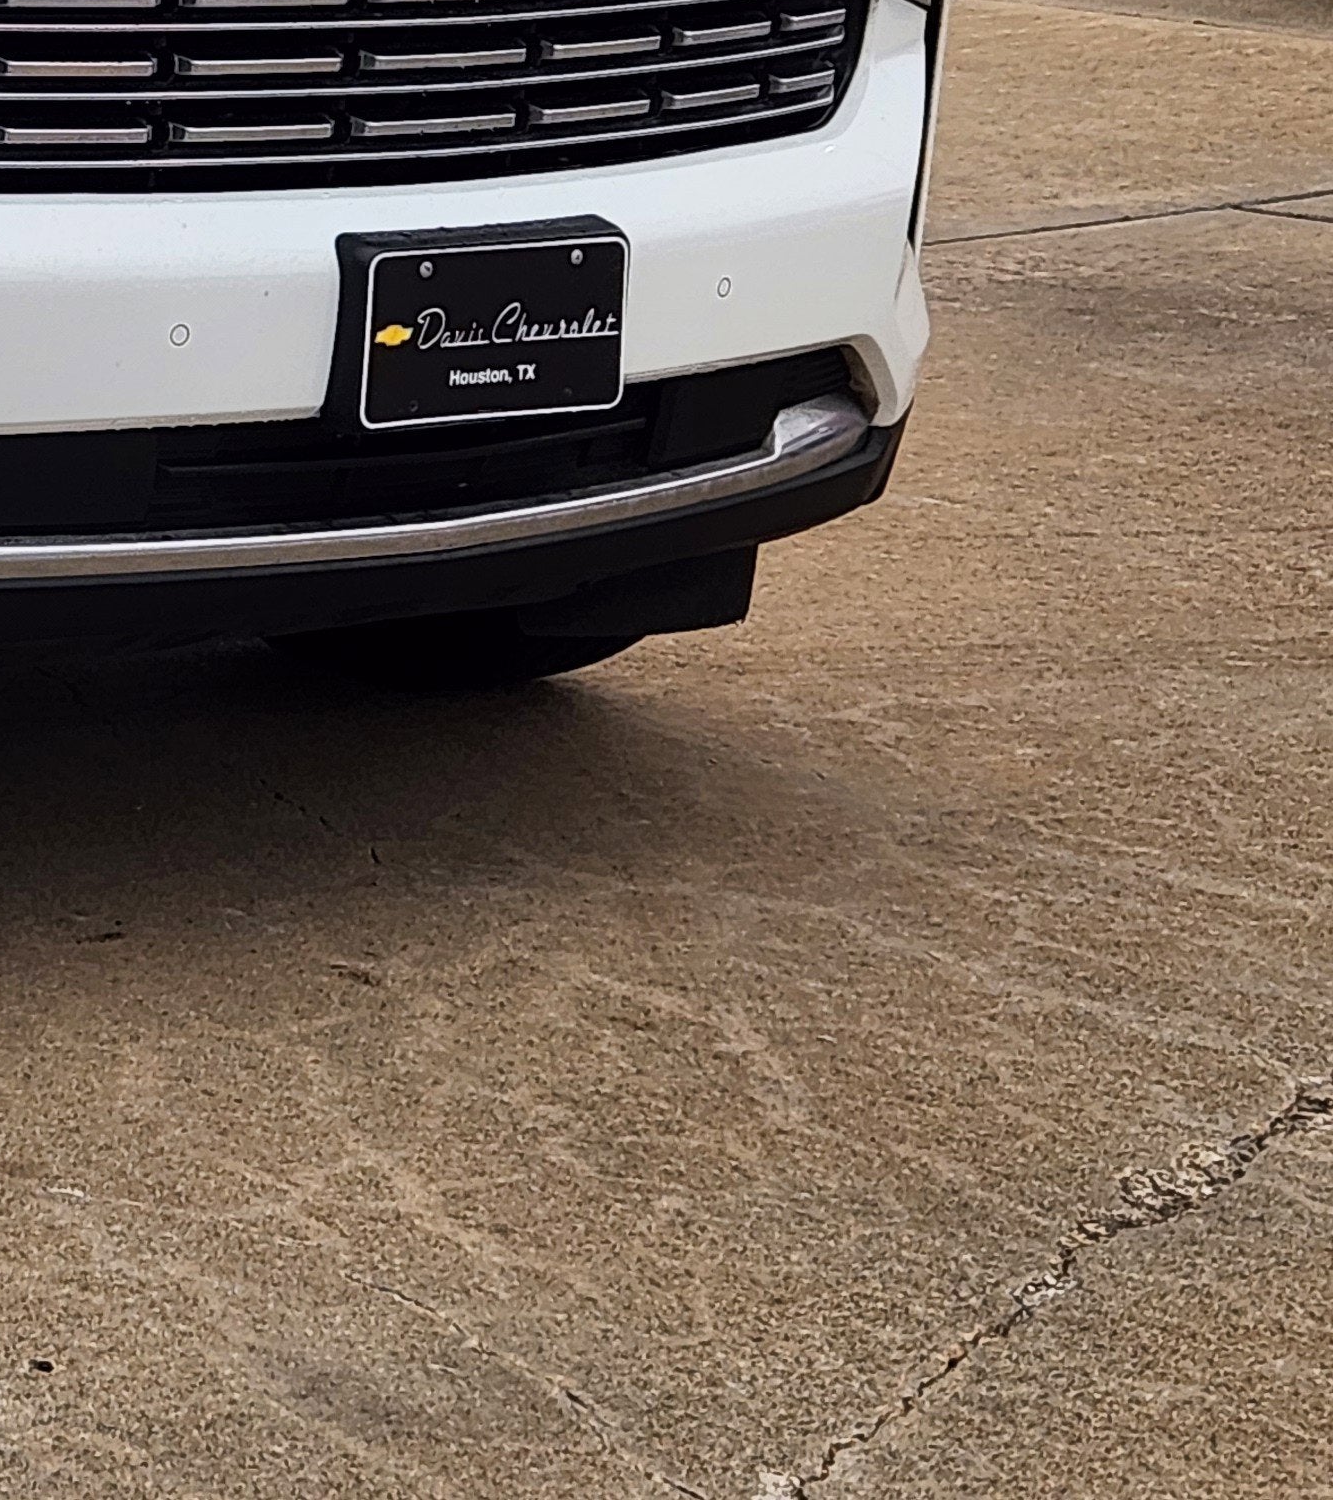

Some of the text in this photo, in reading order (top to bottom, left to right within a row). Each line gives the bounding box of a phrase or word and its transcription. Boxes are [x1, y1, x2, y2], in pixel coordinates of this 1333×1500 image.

[417, 302, 619, 350] Davis Chevrolet
[449, 364, 536, 386] Houston, TX
